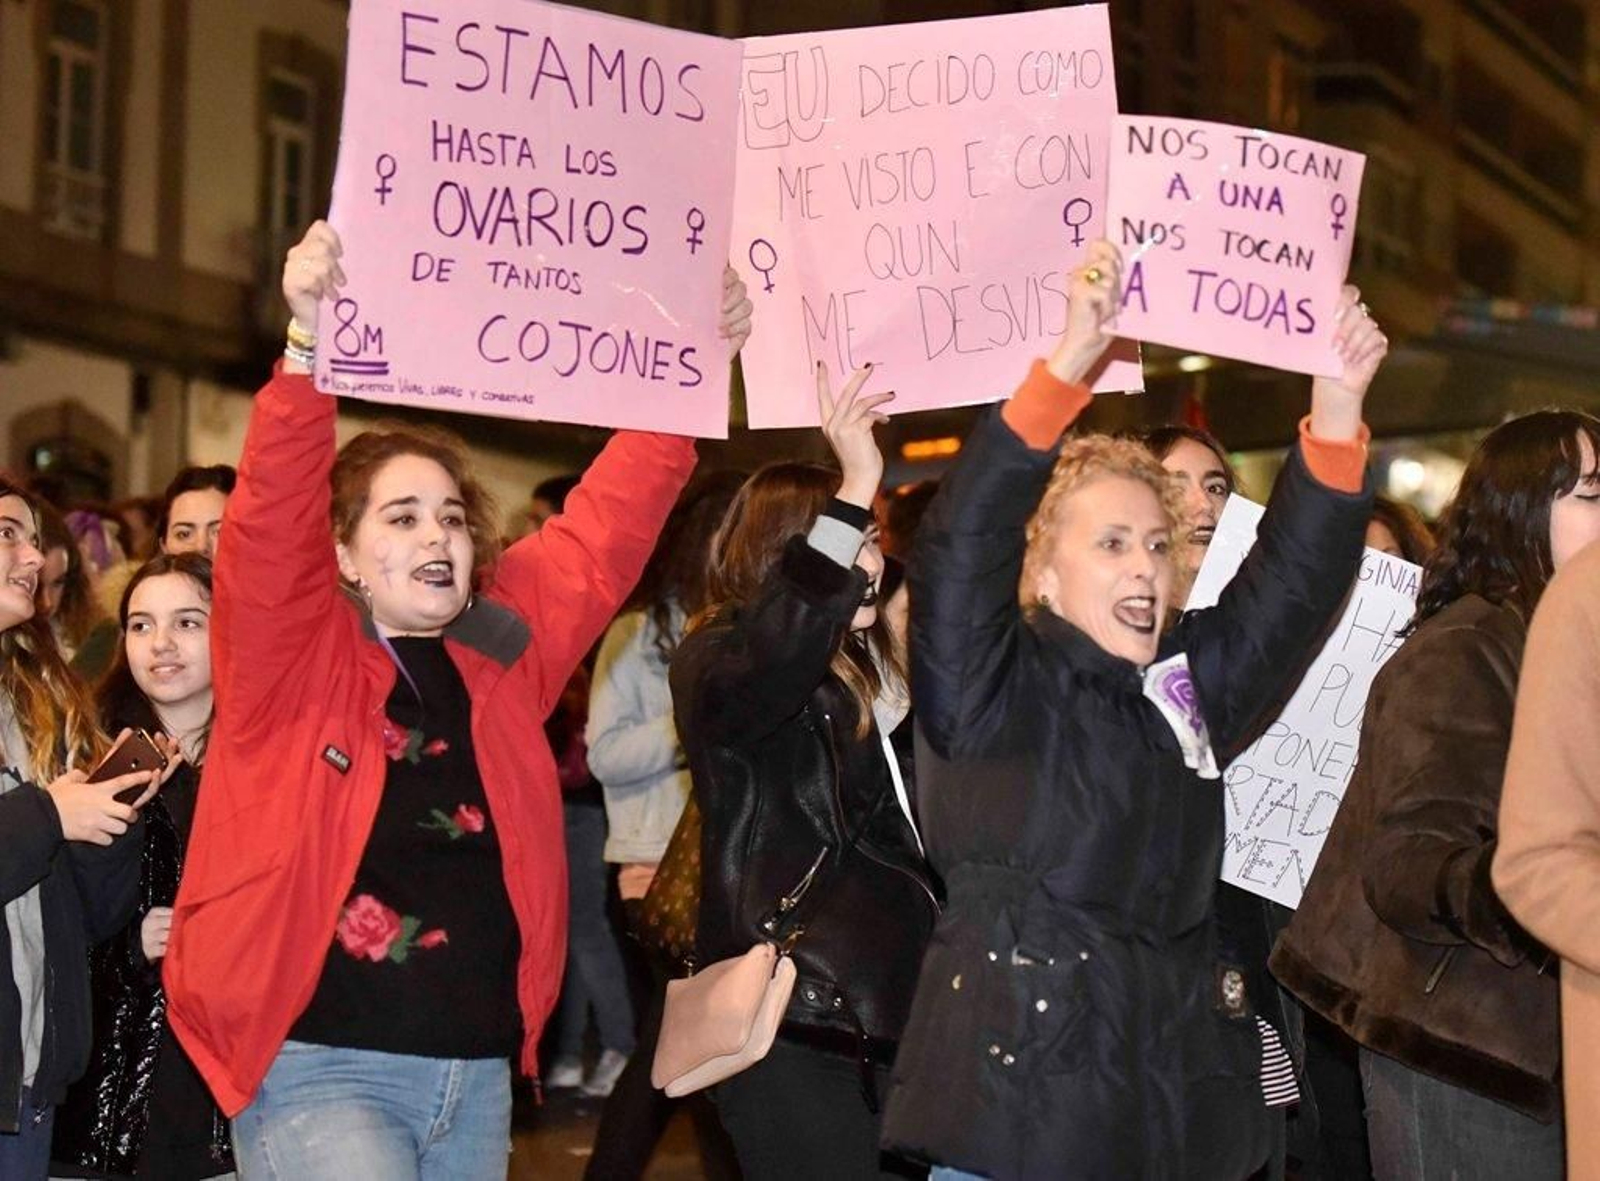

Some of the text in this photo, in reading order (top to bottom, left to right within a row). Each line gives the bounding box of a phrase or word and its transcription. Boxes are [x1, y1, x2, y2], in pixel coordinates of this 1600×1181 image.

[401, 12, 704, 122] ESTAMOS
[743, 46, 1102, 150] EU DECIDO COMO
[432, 119, 618, 177] HASTA LOS
[778, 134, 1092, 221] ME VISTO E CON
[1128, 125, 1343, 182] NOS TOCAN
[433, 181, 649, 255] OVARIOS
[1166, 172, 1285, 216] A UNA
[411, 252, 583, 295] DE TANTOS
[865, 221, 960, 280] QUN
[1121, 216, 1315, 271] NOS TOCAN
[334, 298, 384, 358] 8M
[802, 272, 1072, 375] ME DESVIS
[1121, 261, 1316, 335] A TODAS
[477, 314, 703, 388] COJONES
[1356, 554, 1420, 597] GINIA
[1309, 663, 1367, 731] PU
[1245, 721, 1359, 784] PONE
[1224, 764, 1343, 837] RTAD
[1224, 831, 1305, 892] MEN
